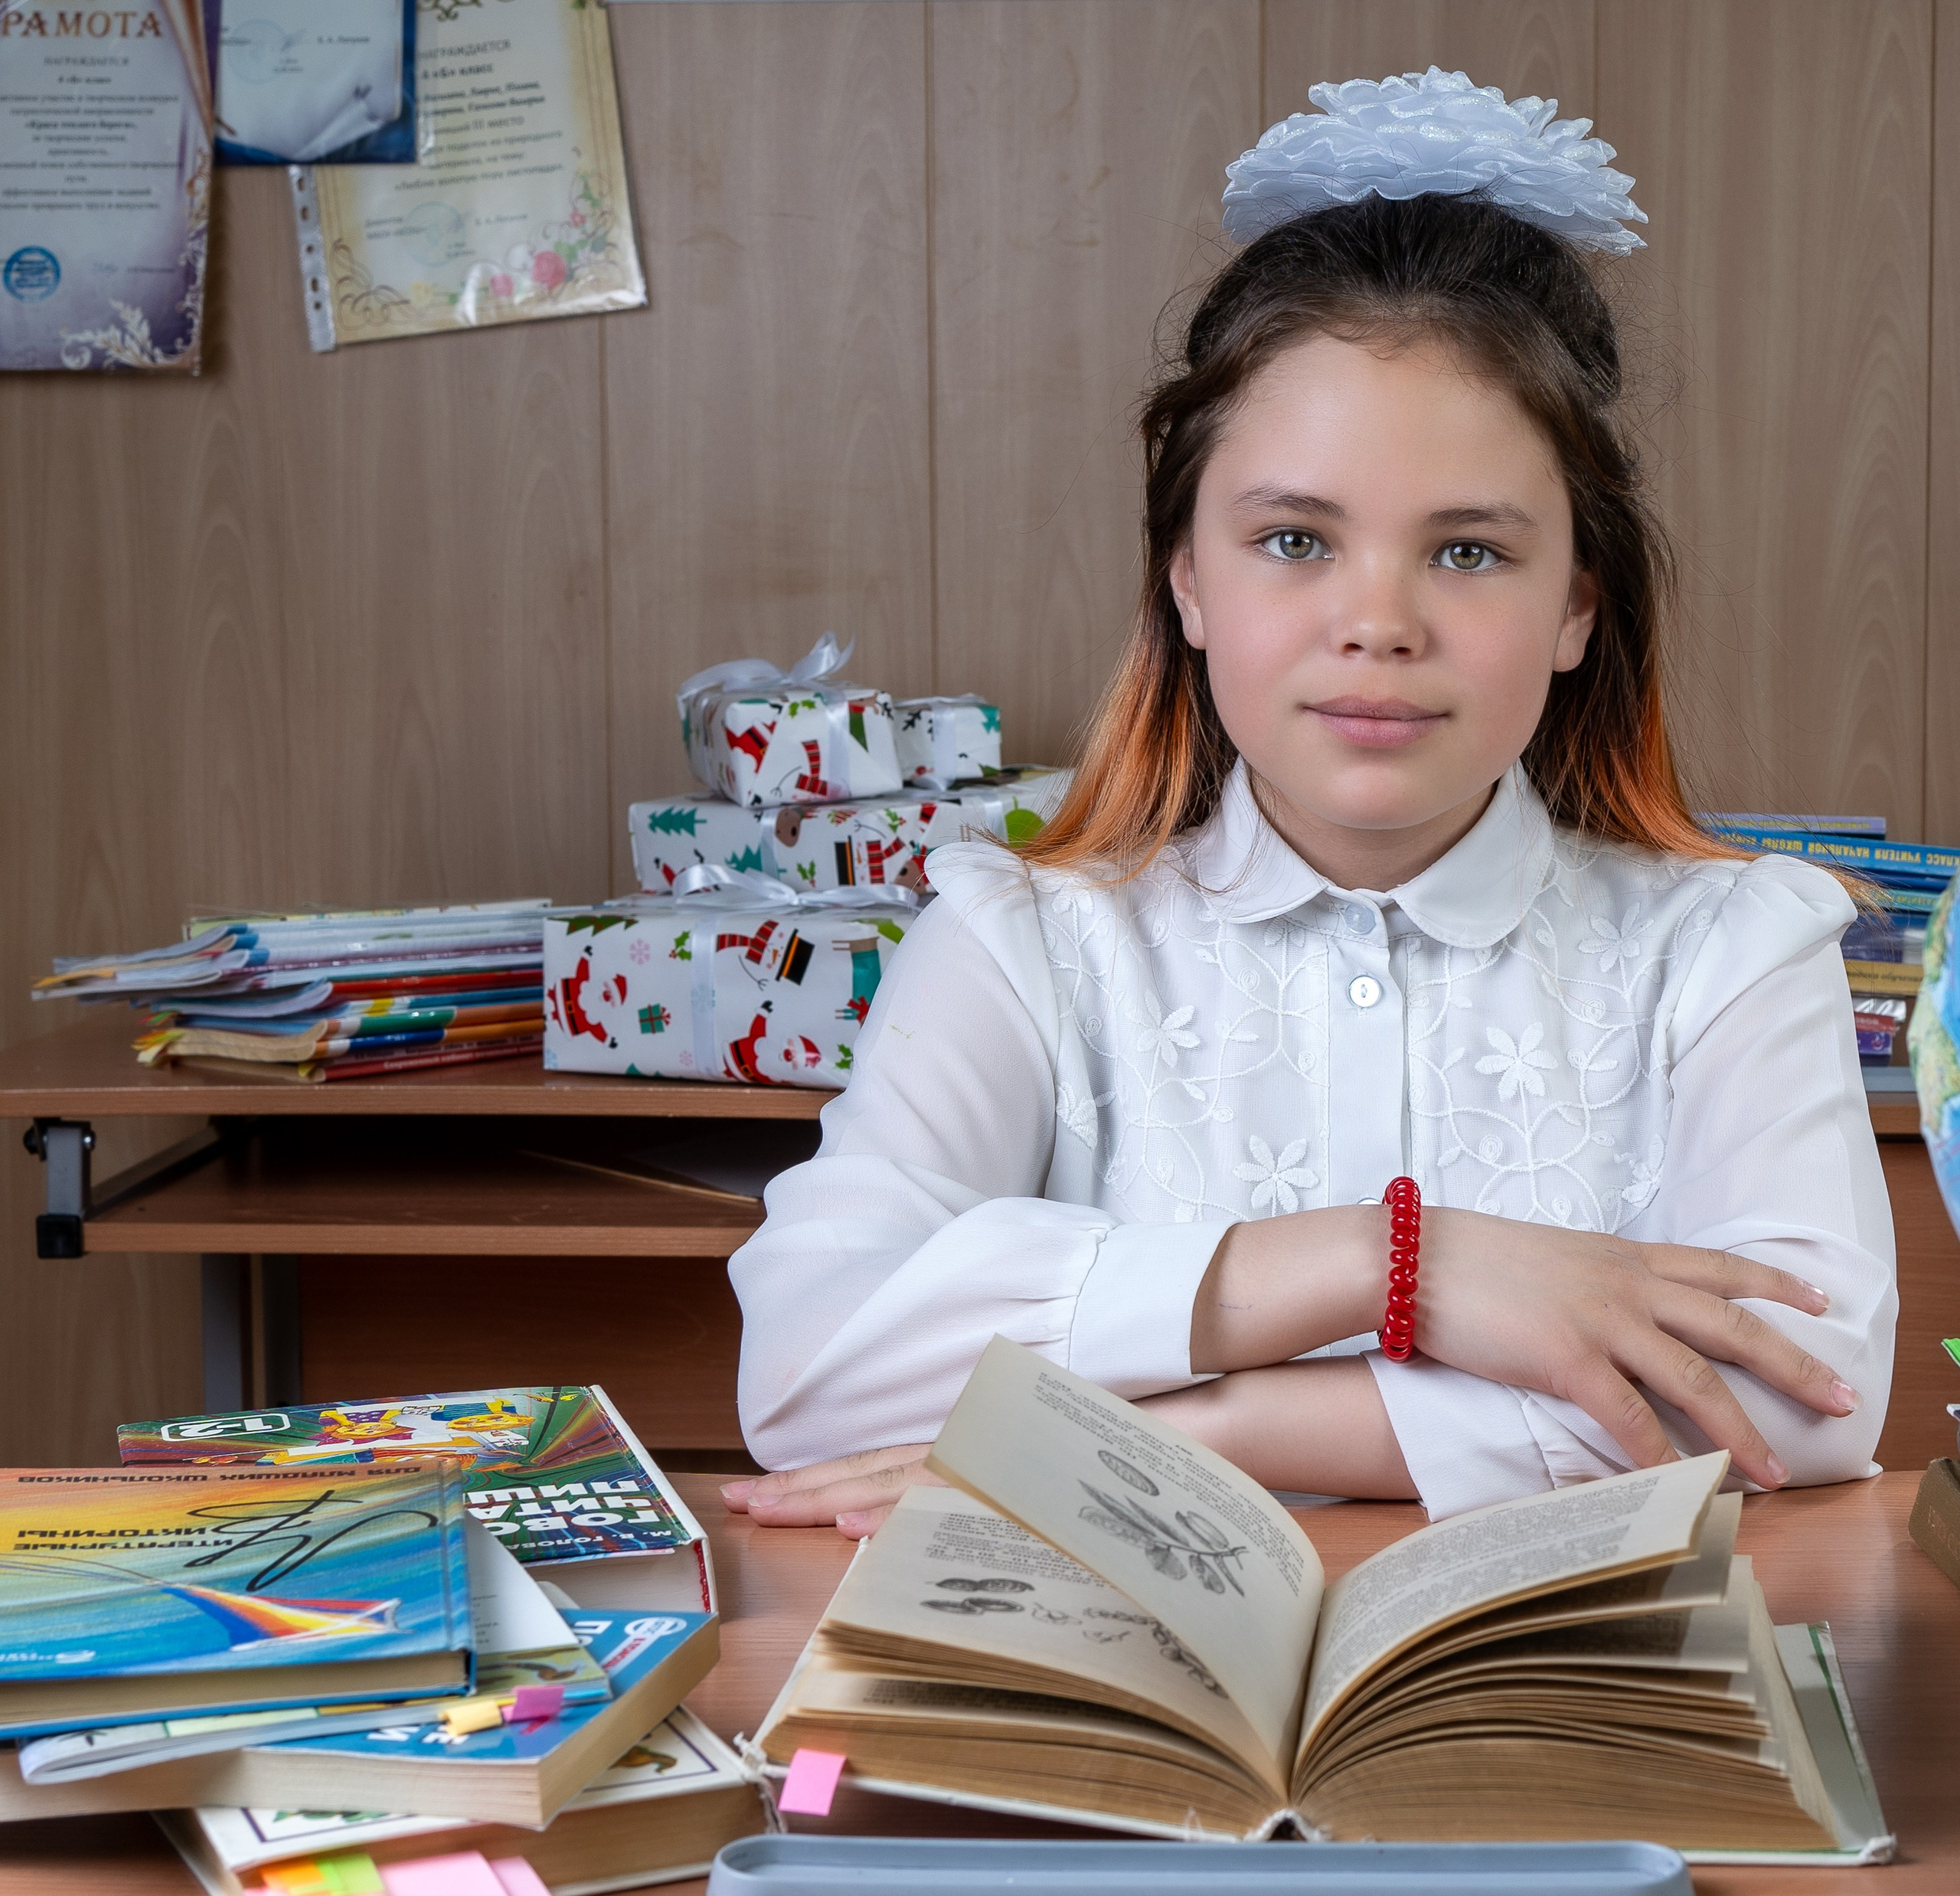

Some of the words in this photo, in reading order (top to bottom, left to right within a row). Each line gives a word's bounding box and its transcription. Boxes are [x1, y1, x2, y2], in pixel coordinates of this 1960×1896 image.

[179, 1417, 273, 1437] 1-2
[219, 1469, 356, 1481] МЛАДШИХ
[368, 1466, 422, 1476] ДЛЯ
[18, 1474, 208, 1483] ШКОЛЬНИКОВ
[464, 1479, 641, 1505] ПИШ
